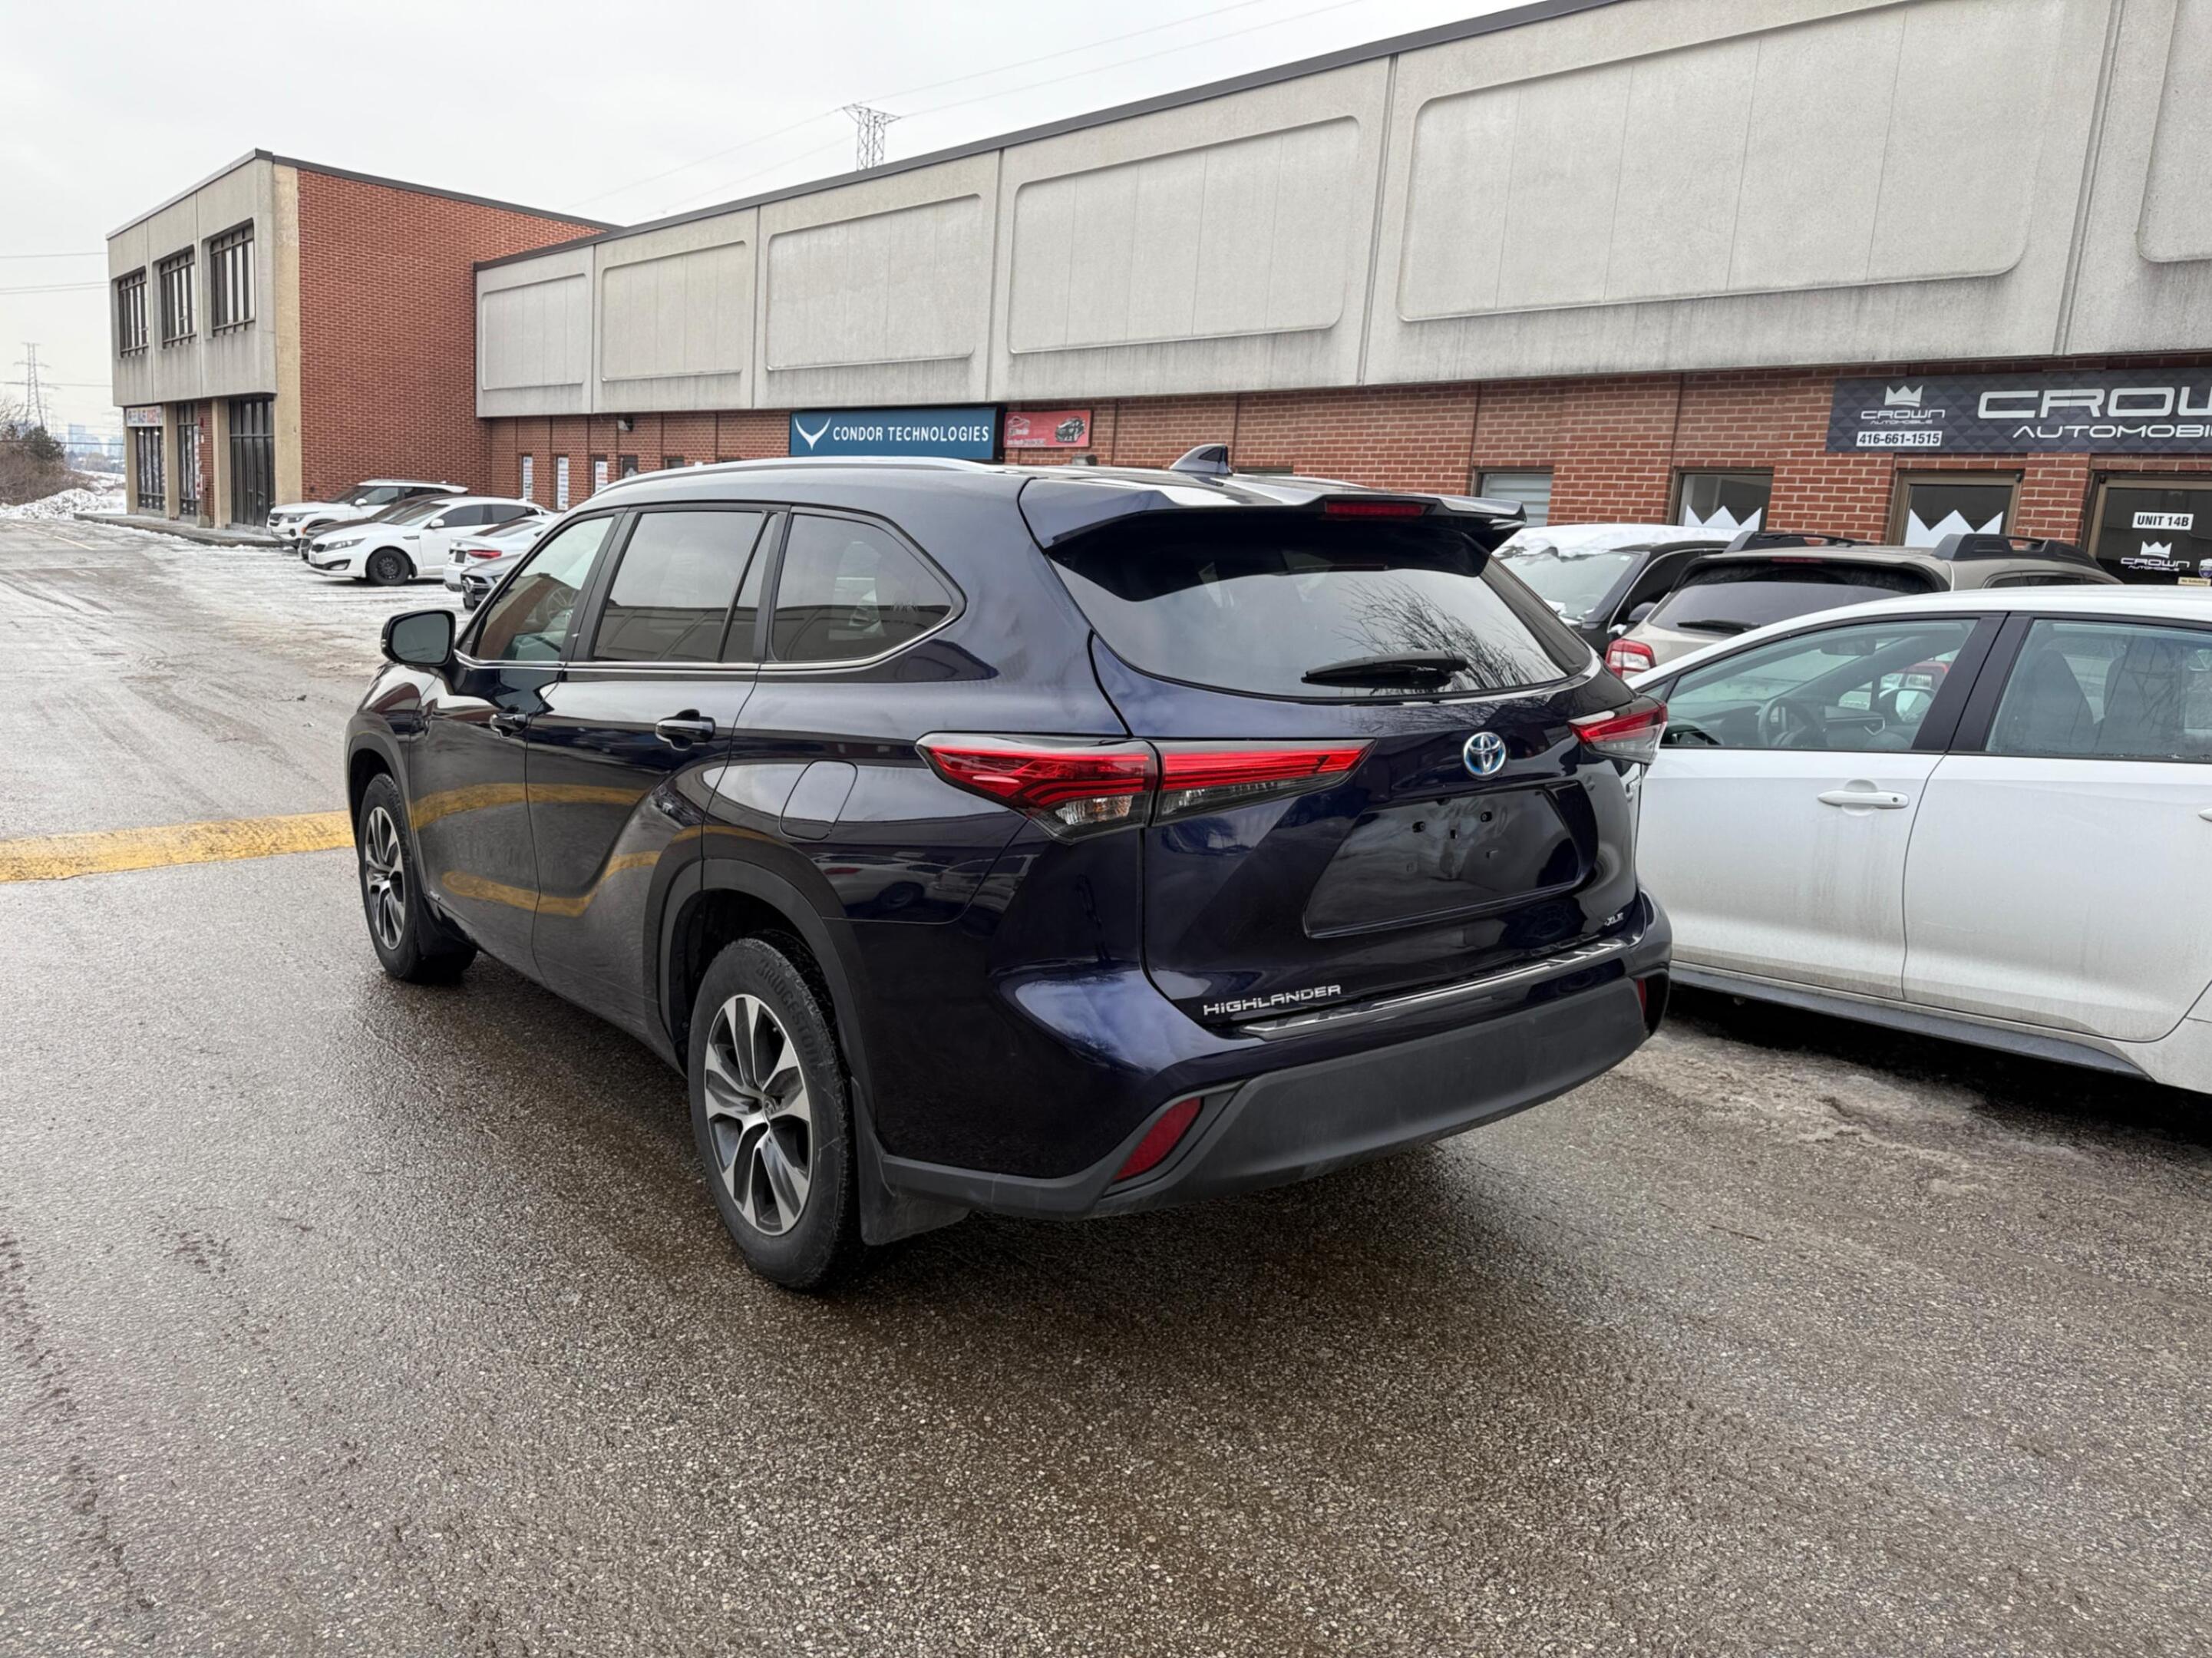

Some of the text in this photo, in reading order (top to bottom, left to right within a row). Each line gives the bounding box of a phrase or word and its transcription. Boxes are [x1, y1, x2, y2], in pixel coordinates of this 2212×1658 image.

[1860, 409, 1946, 419] CROWN
[833, 426, 883, 441] CONDOR
[888, 425, 989, 442] TECHNOLOGIES
[2012, 424, 2212, 438] AUTOMOBI
[1858, 433, 1940, 444] 416-661-1515
[2137, 515, 2190, 527] UNIT 14B
[2121, 557, 2190, 568] CROWN
[1203, 984, 1342, 1016] HIGHLANDER
